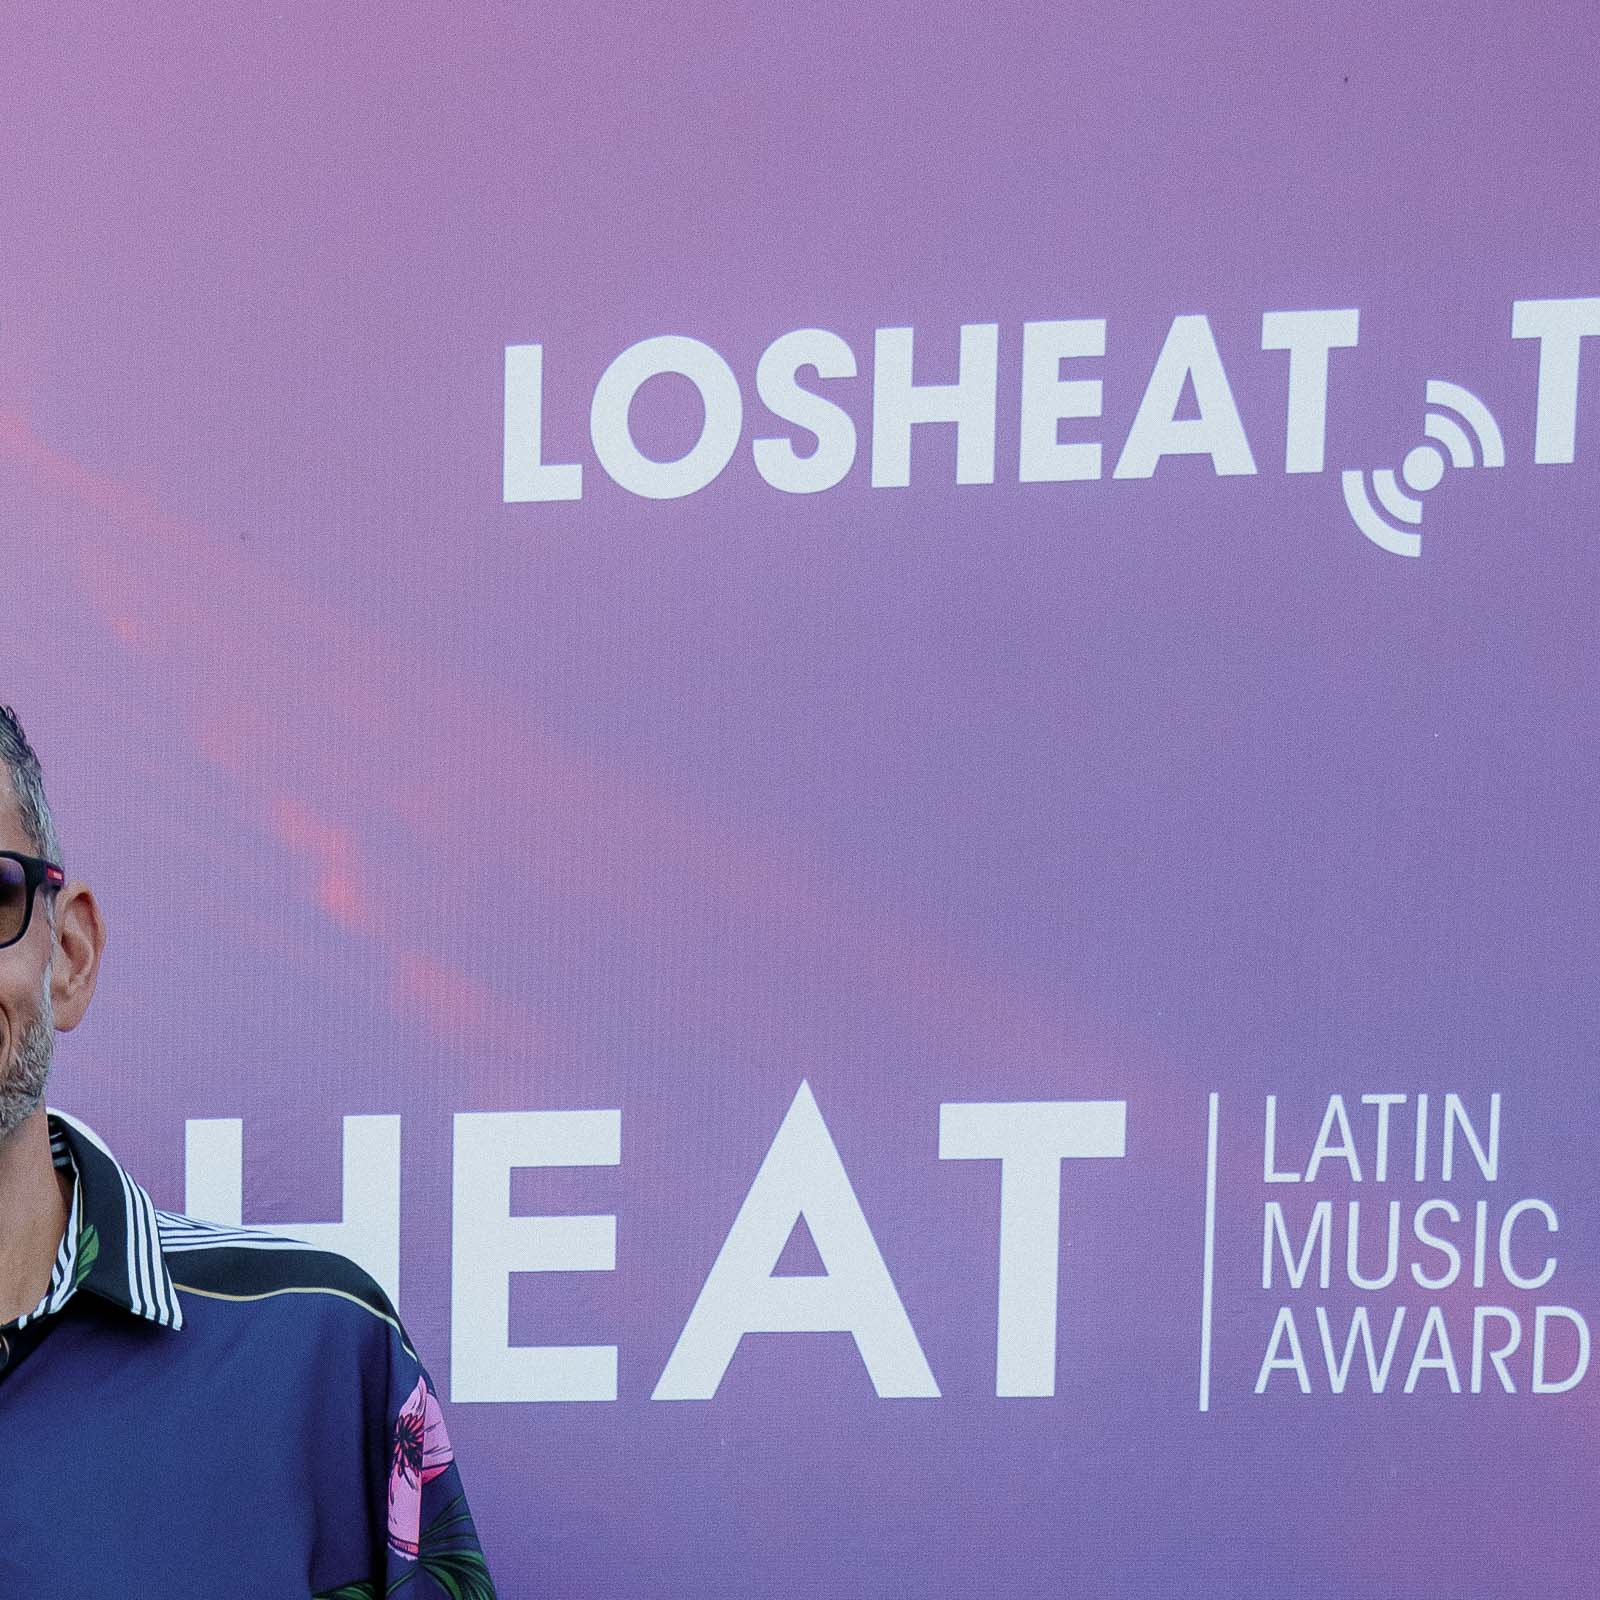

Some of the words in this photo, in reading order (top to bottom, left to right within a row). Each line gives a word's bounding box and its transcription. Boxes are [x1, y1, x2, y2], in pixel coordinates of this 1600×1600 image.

[503, 309, 1361, 503] LOSHEAT
[1263, 1093, 1501, 1183] LATIN
[1262, 1198, 1559, 1290] MUSIC
[1254, 1305, 1591, 1394] AWARD
